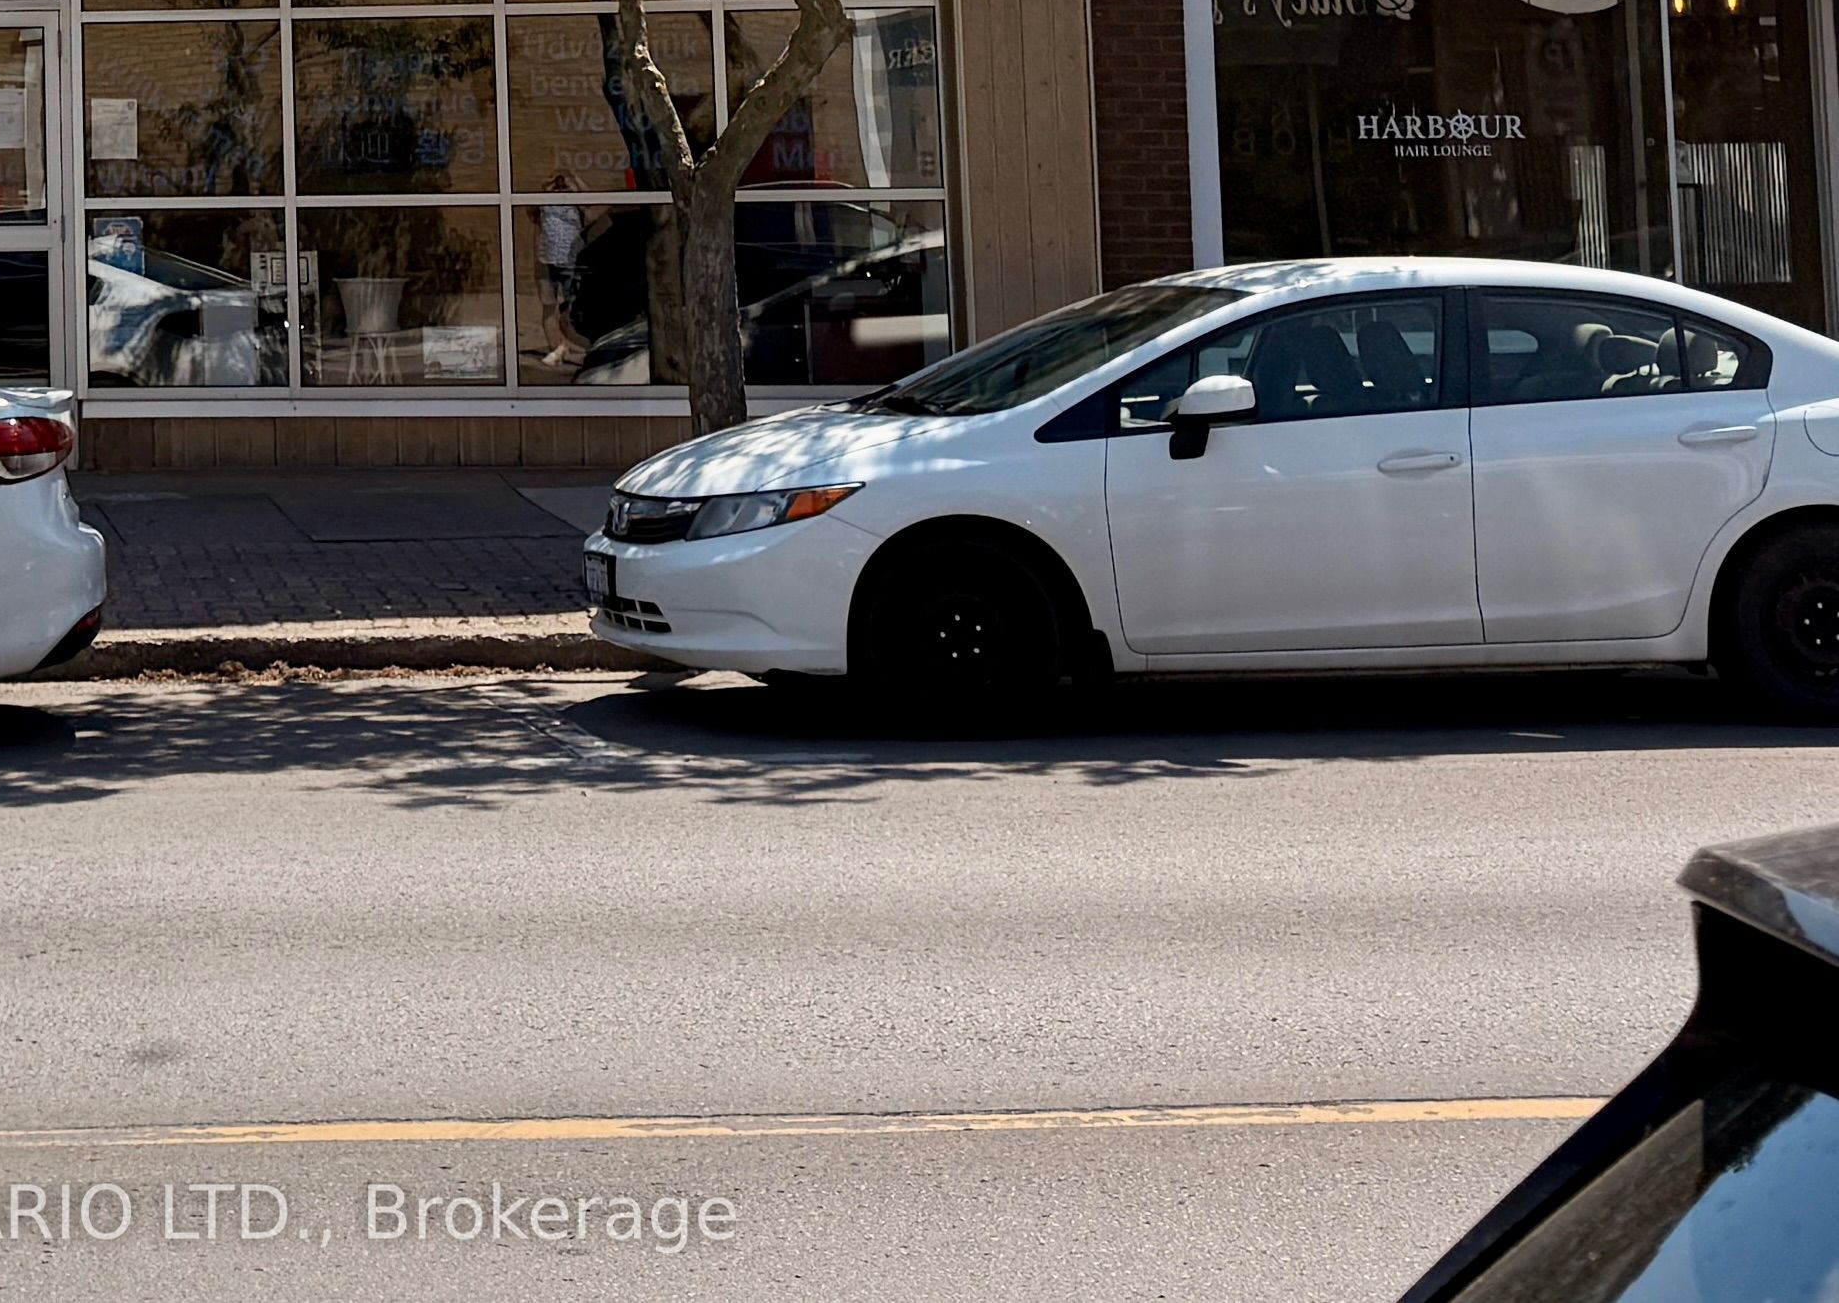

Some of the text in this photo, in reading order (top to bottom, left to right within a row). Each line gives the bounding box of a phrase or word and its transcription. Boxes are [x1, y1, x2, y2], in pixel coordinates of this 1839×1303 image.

[1357, 111, 1527, 143] HARBOUR
[1395, 144, 1492, 158] HAIR LOUNGE
